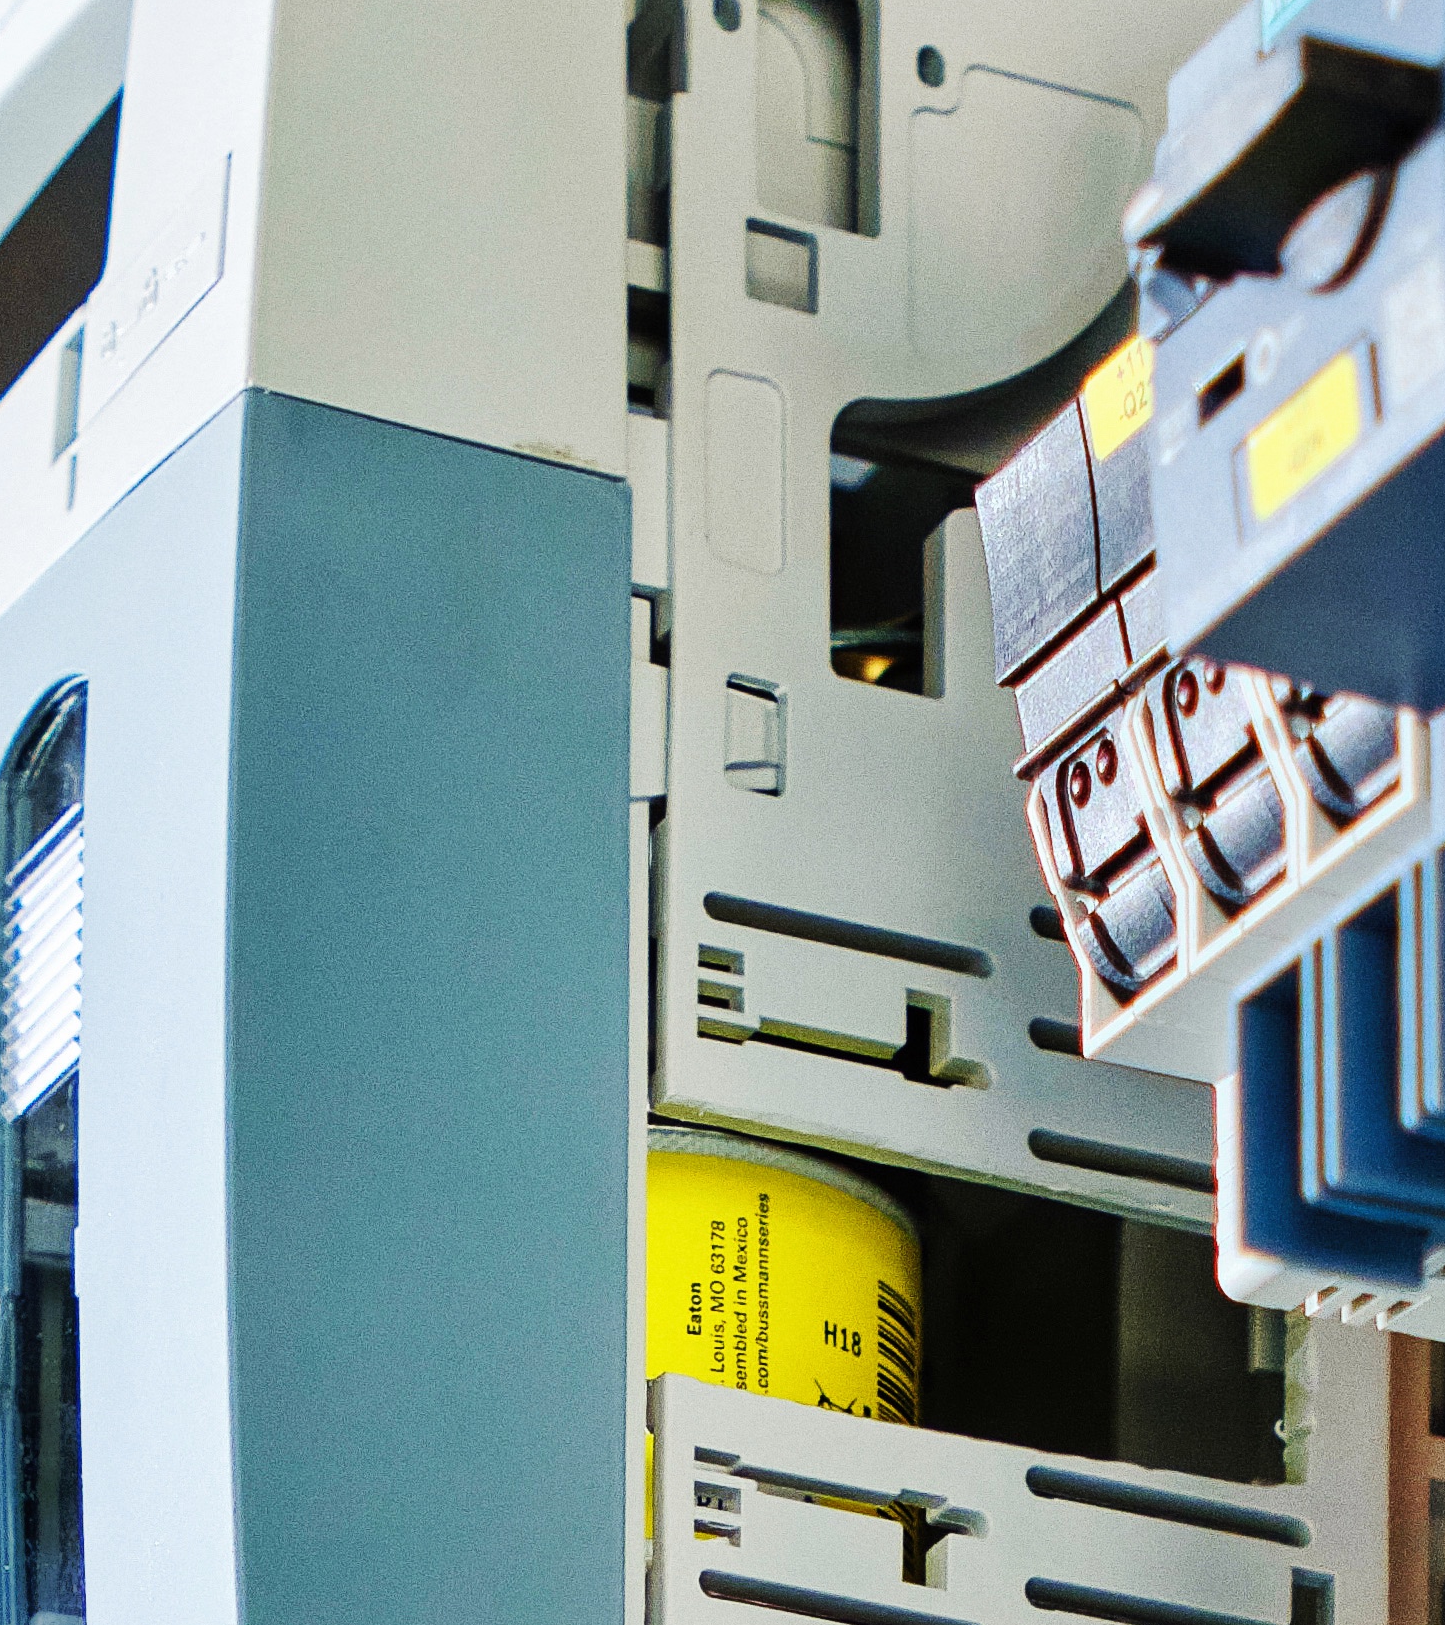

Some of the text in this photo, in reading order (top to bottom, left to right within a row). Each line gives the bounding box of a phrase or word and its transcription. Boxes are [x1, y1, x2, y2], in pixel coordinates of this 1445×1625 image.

[1116, 341, 1145, 382] +11
[1119, 380, 1151, 420] -Q2
[686, 1282, 702, 1336] Eaton
[709, 1220, 727, 1373] Louis, MO 63178
[732, 1217, 748, 1391] sembled in Mexico
[755, 1193, 771, 1395] .com/bussmannseries
[824, 1320, 862, 1357] H18
